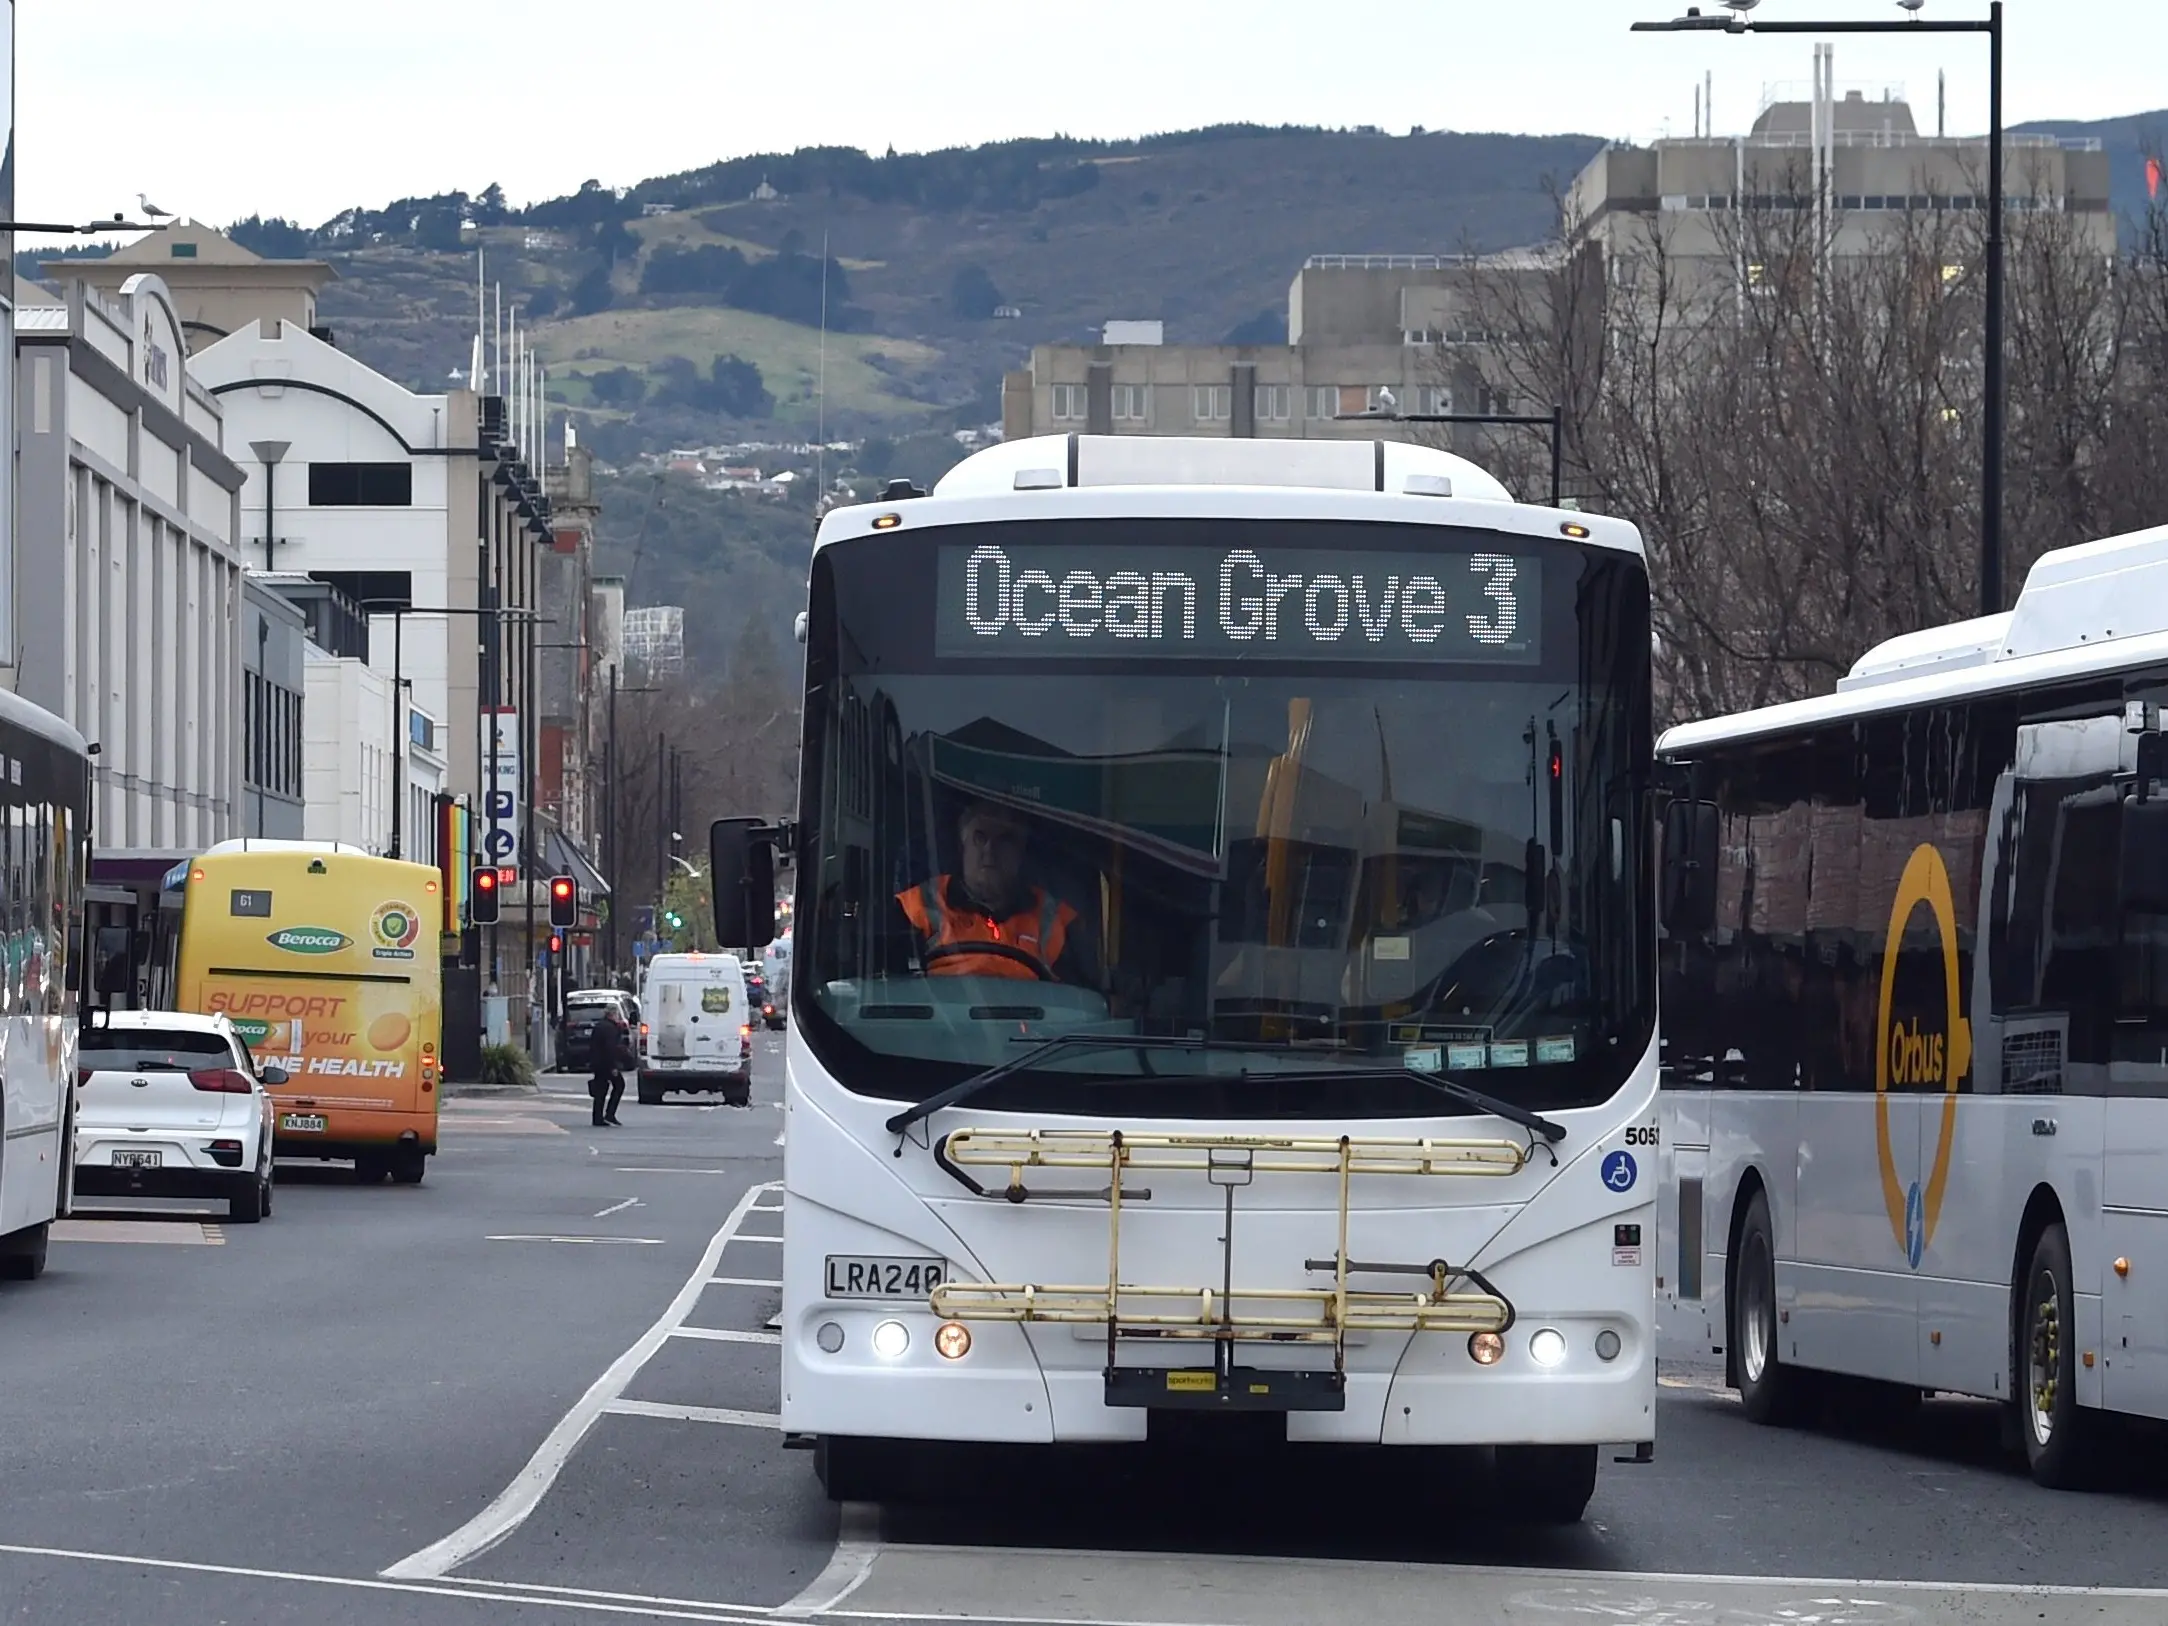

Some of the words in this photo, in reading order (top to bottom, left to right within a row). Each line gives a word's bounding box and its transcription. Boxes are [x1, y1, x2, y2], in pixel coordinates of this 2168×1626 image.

[966, 545, 1195, 638] Ocean
[1219, 549, 1445, 643] Grove
[1465, 553, 1518, 644] 3
[278, 932, 341, 947] Berocca
[207, 991, 346, 1020] SUPPORT
[301, 1031, 357, 1049] your
[1892, 1016, 1943, 1084] Orbus
[307, 1056, 405, 1078] HEALTH
[830, 1262, 942, 1294] LRA240
